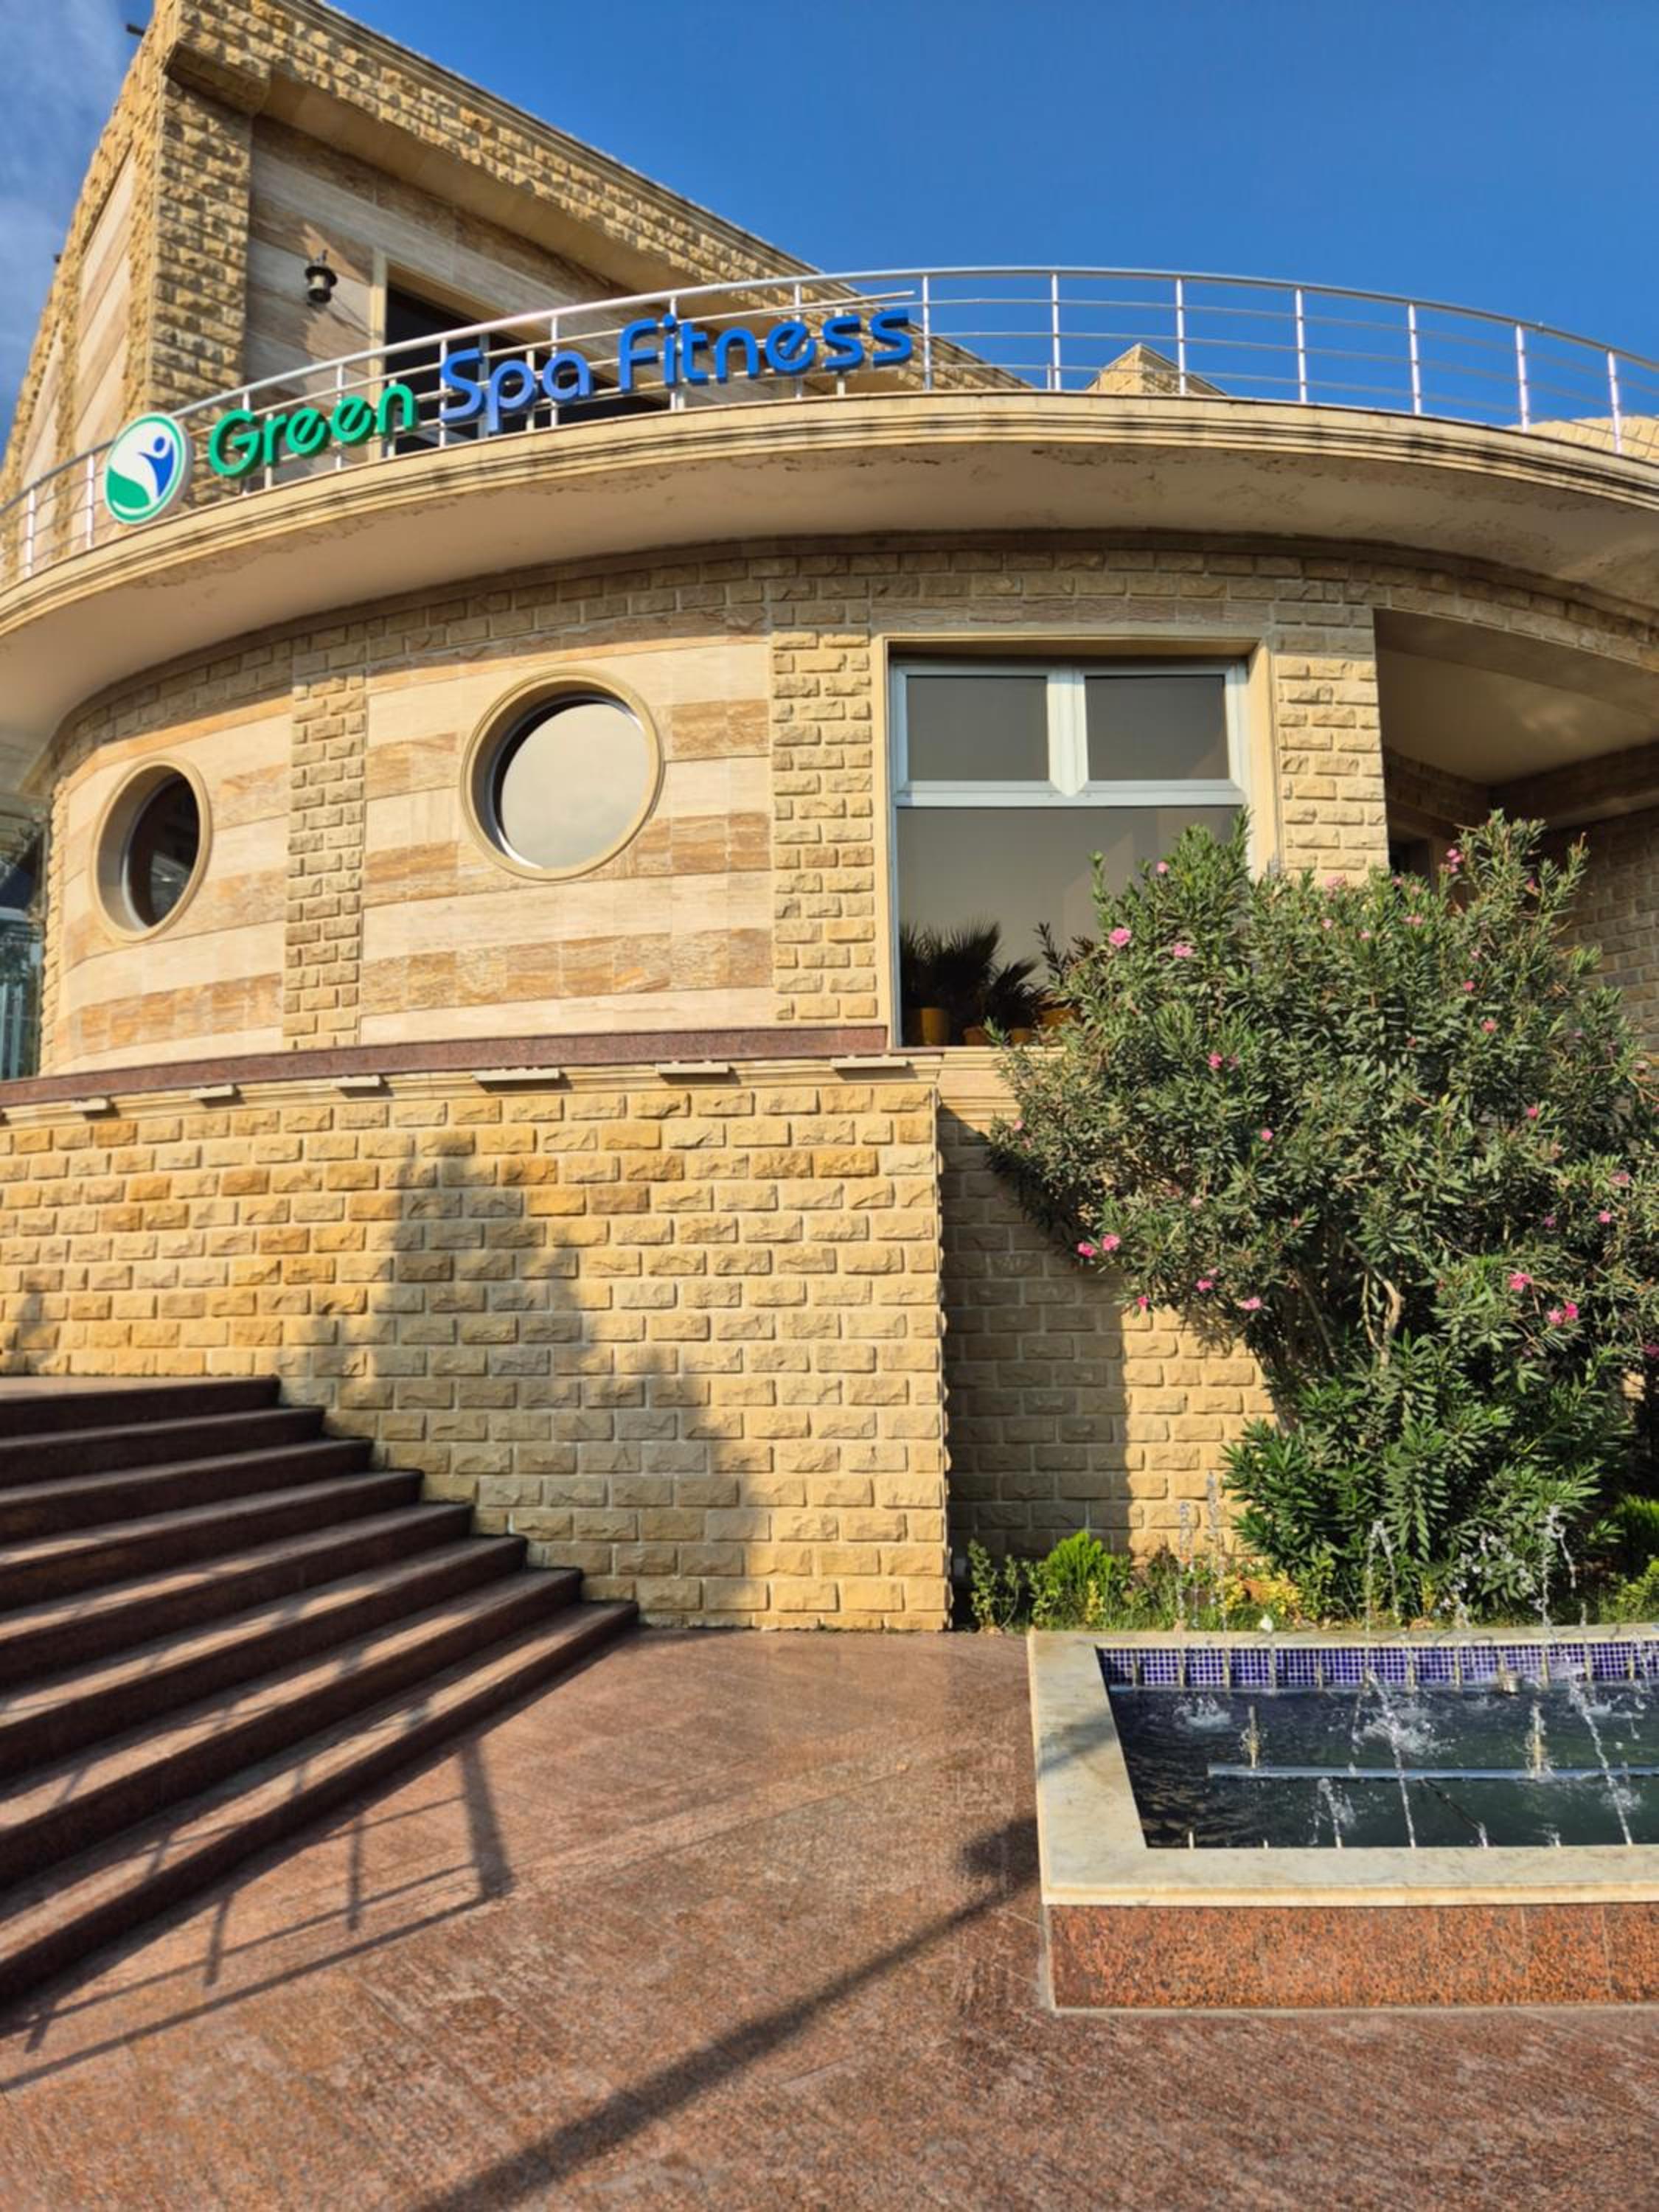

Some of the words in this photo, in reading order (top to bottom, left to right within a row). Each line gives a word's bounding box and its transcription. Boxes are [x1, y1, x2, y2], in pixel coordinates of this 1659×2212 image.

[207, 383, 418, 479] Green
[439, 348, 591, 433] Spa
[619, 308, 914, 397] Fitness
